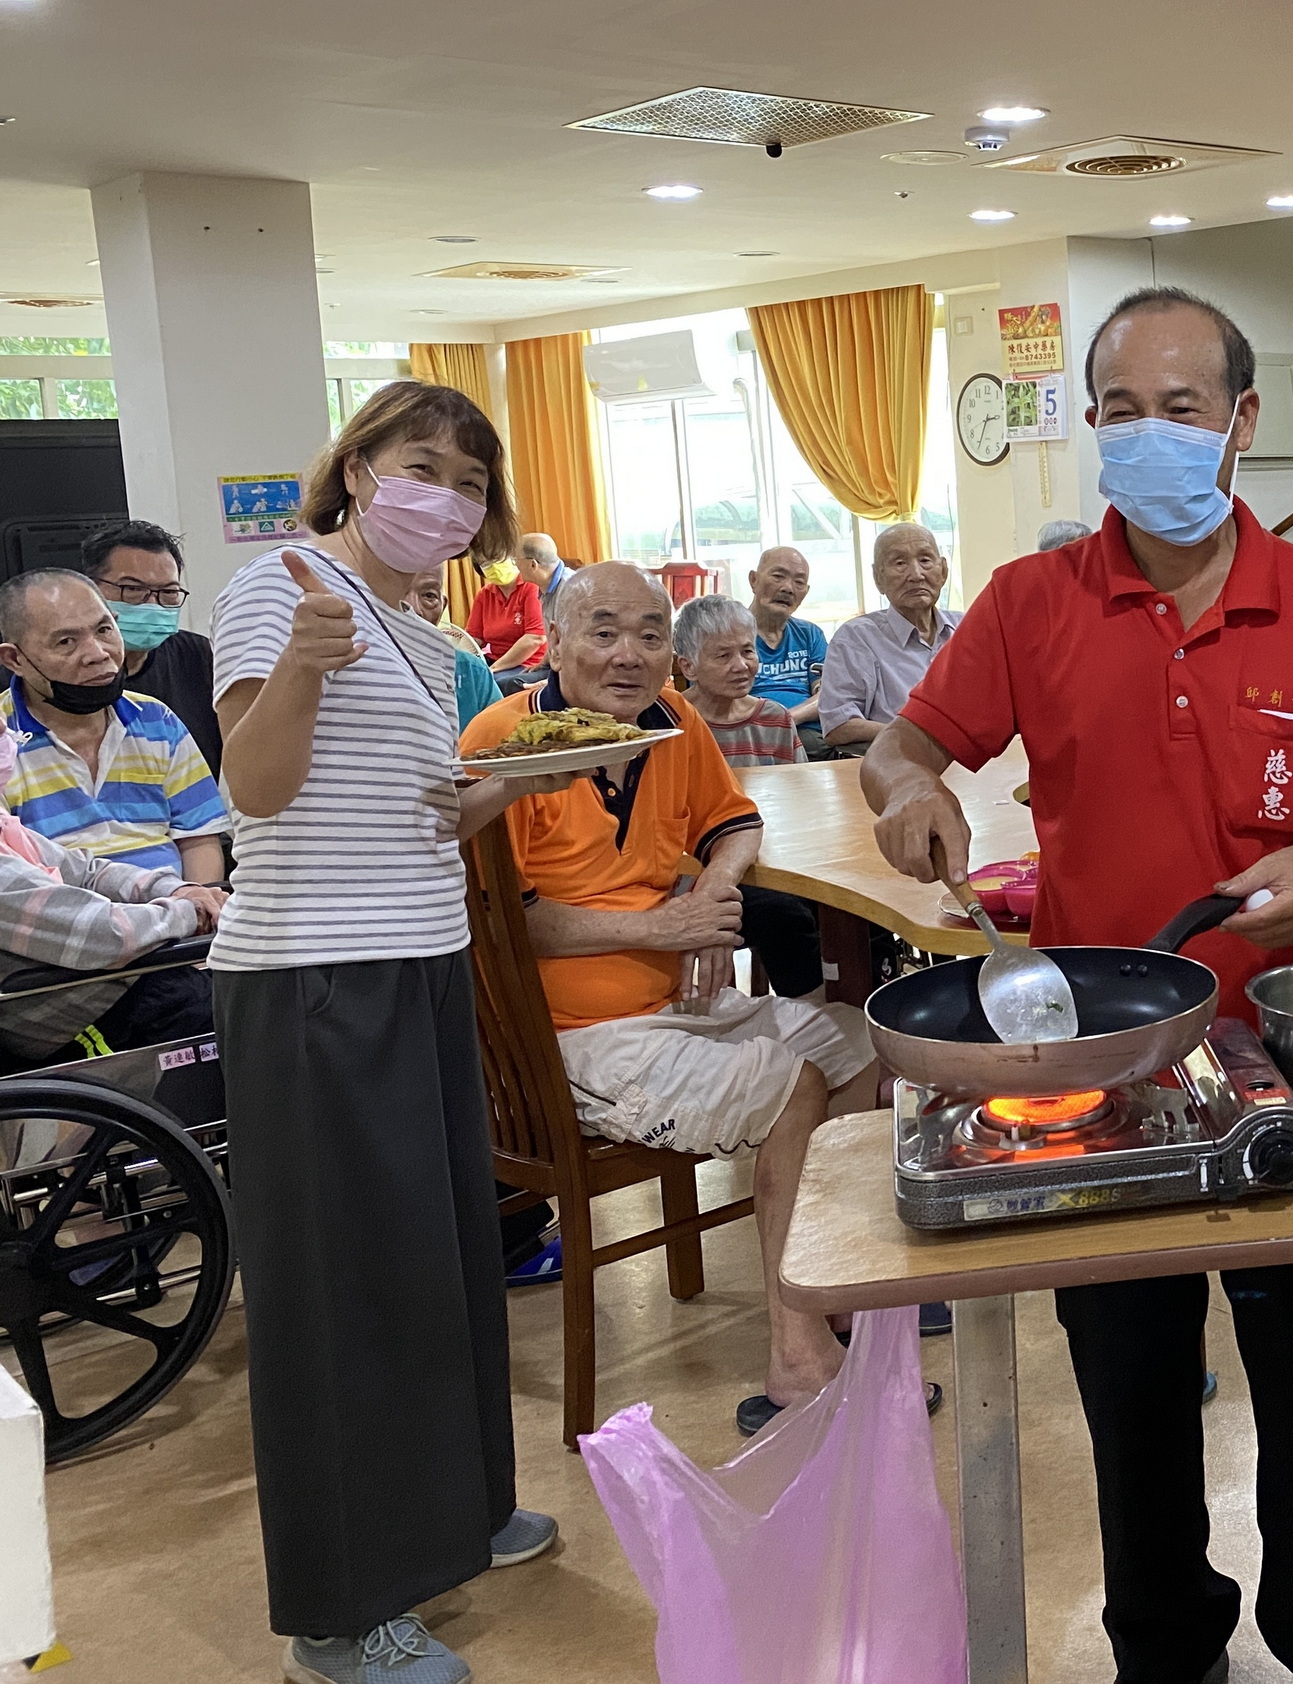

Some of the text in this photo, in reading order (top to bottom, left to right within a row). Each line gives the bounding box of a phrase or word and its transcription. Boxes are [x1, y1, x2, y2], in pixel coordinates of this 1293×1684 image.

[1045, 387, 1057, 416] 5
[1258, 749, 1293, 820] 慈惠
[641, 1118, 676, 1143] WEAR
